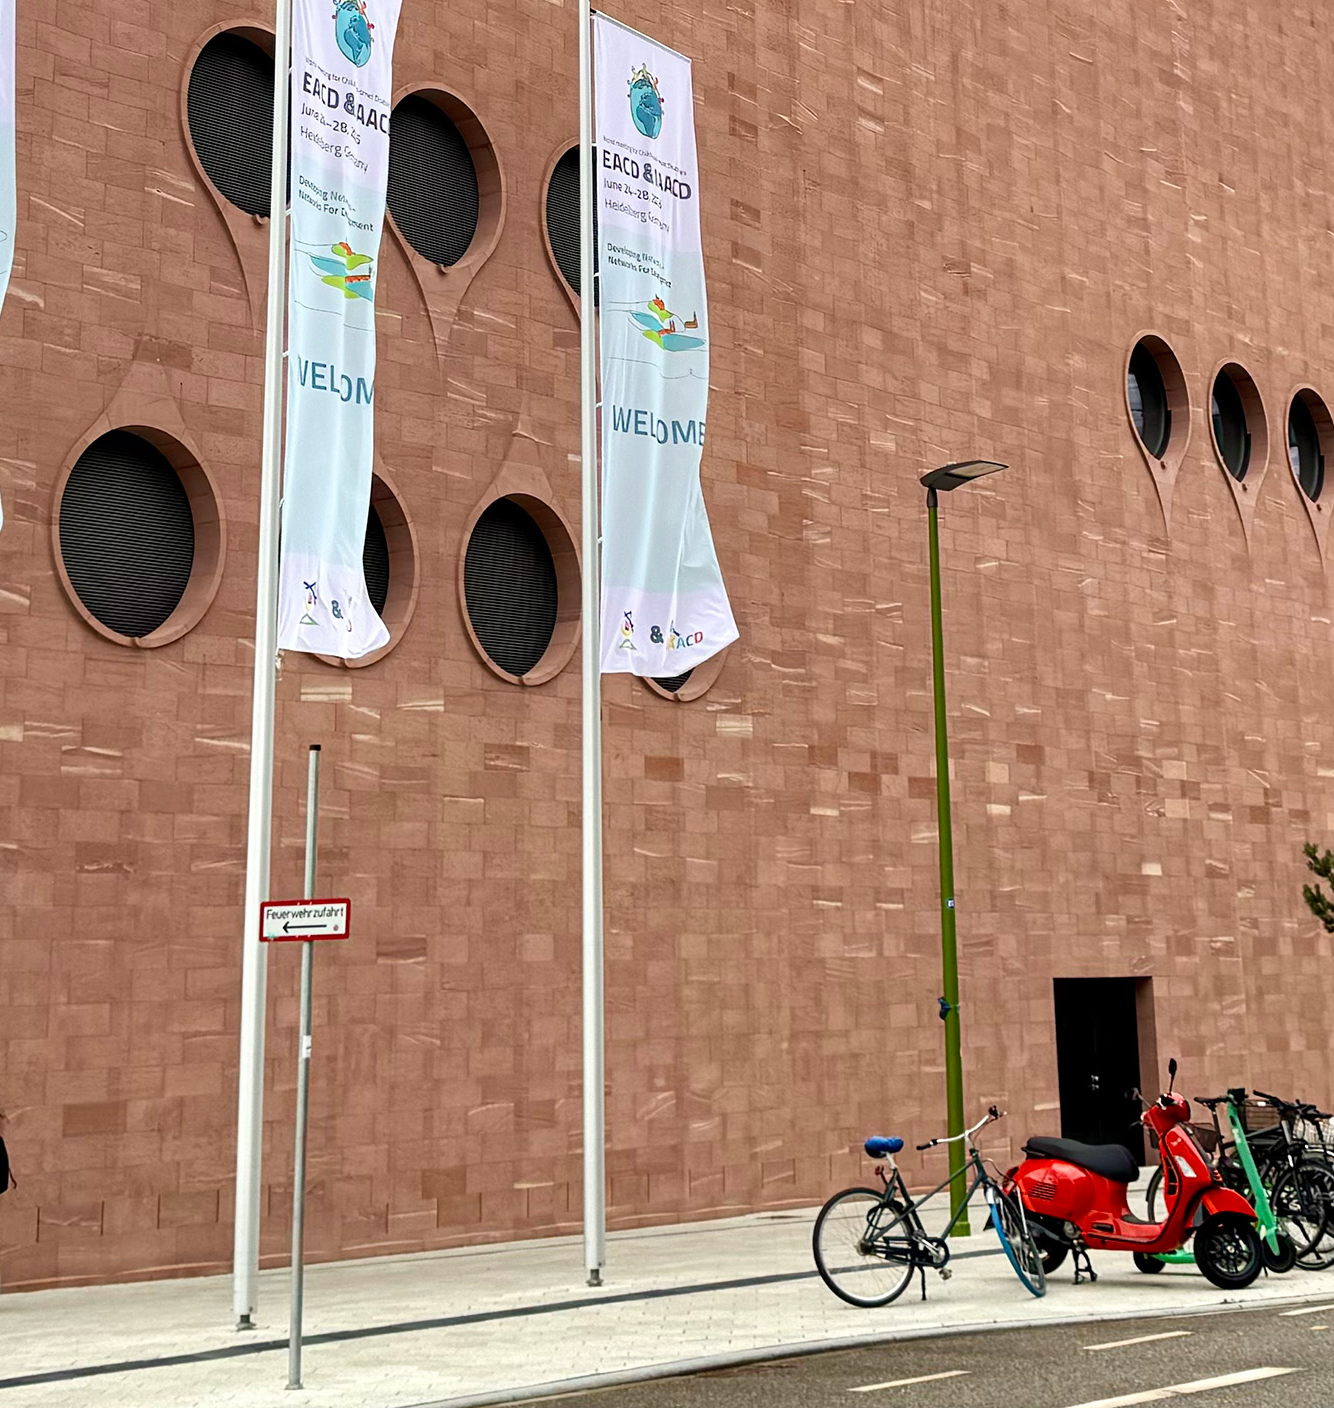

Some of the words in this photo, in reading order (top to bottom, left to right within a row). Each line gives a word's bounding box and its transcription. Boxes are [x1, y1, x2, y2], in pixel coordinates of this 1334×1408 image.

[303, 71, 340, 109] EACD
[603, 149, 639, 179] EACD
[643, 162, 654, 185] &
[603, 178, 623, 192] June
[323, 203, 338, 215] For
[650, 625, 664, 644] &
[266, 906, 344, 920] Feuerwehrzufahrt
